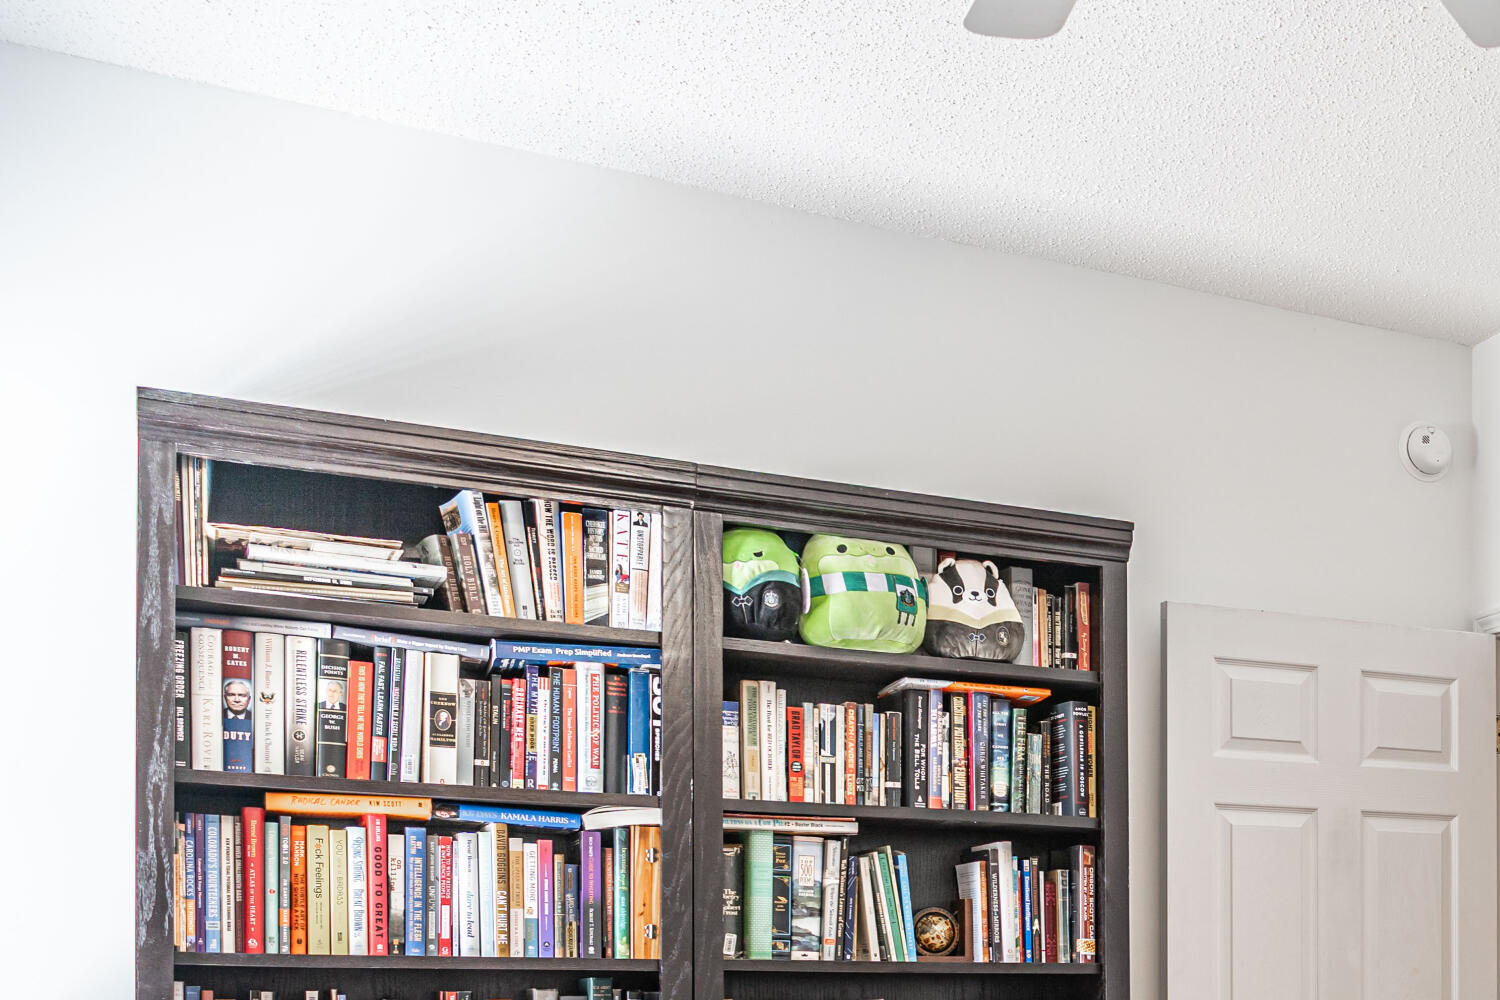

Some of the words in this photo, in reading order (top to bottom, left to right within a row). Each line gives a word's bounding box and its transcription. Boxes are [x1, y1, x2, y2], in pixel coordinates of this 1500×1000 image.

[175, 640, 185, 673] FREEZING
[556, 648, 573, 657] Prep
[574, 649, 612, 657] Simplified
[296, 650, 307, 696] RELENTLESS
[377, 675, 385, 691] FAST,
[175, 675, 185, 698] ORDER
[296, 699, 307, 725] STRIKE
[515, 688, 524, 722] ORDINARY
[376, 712, 384, 735] FASTER
[792, 710, 800, 729] BRAD
[1017, 716, 1025, 735] THE
[224, 731, 251, 741] DUTY
[515, 727, 524, 742] MEN
[954, 727, 964, 758] PATTERSON
[792, 733, 800, 758] TAYLOR
[1017, 738, 1025, 761] FIRM
[954, 767, 967, 804] ERUPTION
[291, 796, 328, 806] RADICAL
[500, 812, 536, 821] KAMALA
[538, 814, 568, 824] HARRIS
[208, 827, 217, 868] COLORADO'S
[497, 830, 506, 850] DAVID
[186, 840, 194, 872] CAROLINA
[397, 860, 402, 869] on
[414, 858, 422, 898] INTELLIGENCE
[497, 853, 506, 884] GOGGINS
[186, 875, 194, 896] ROCKS
[208, 870, 217, 918] FOURTEENERS
[375, 883, 382, 896] TO
[497, 890, 507, 911] CAN'T
[375, 902, 383, 938] GREAT
[414, 910, 422, 920] THE
[498, 913, 507, 931] HURT
[414, 923, 422, 942] FLESH
[498, 934, 507, 944] ME
